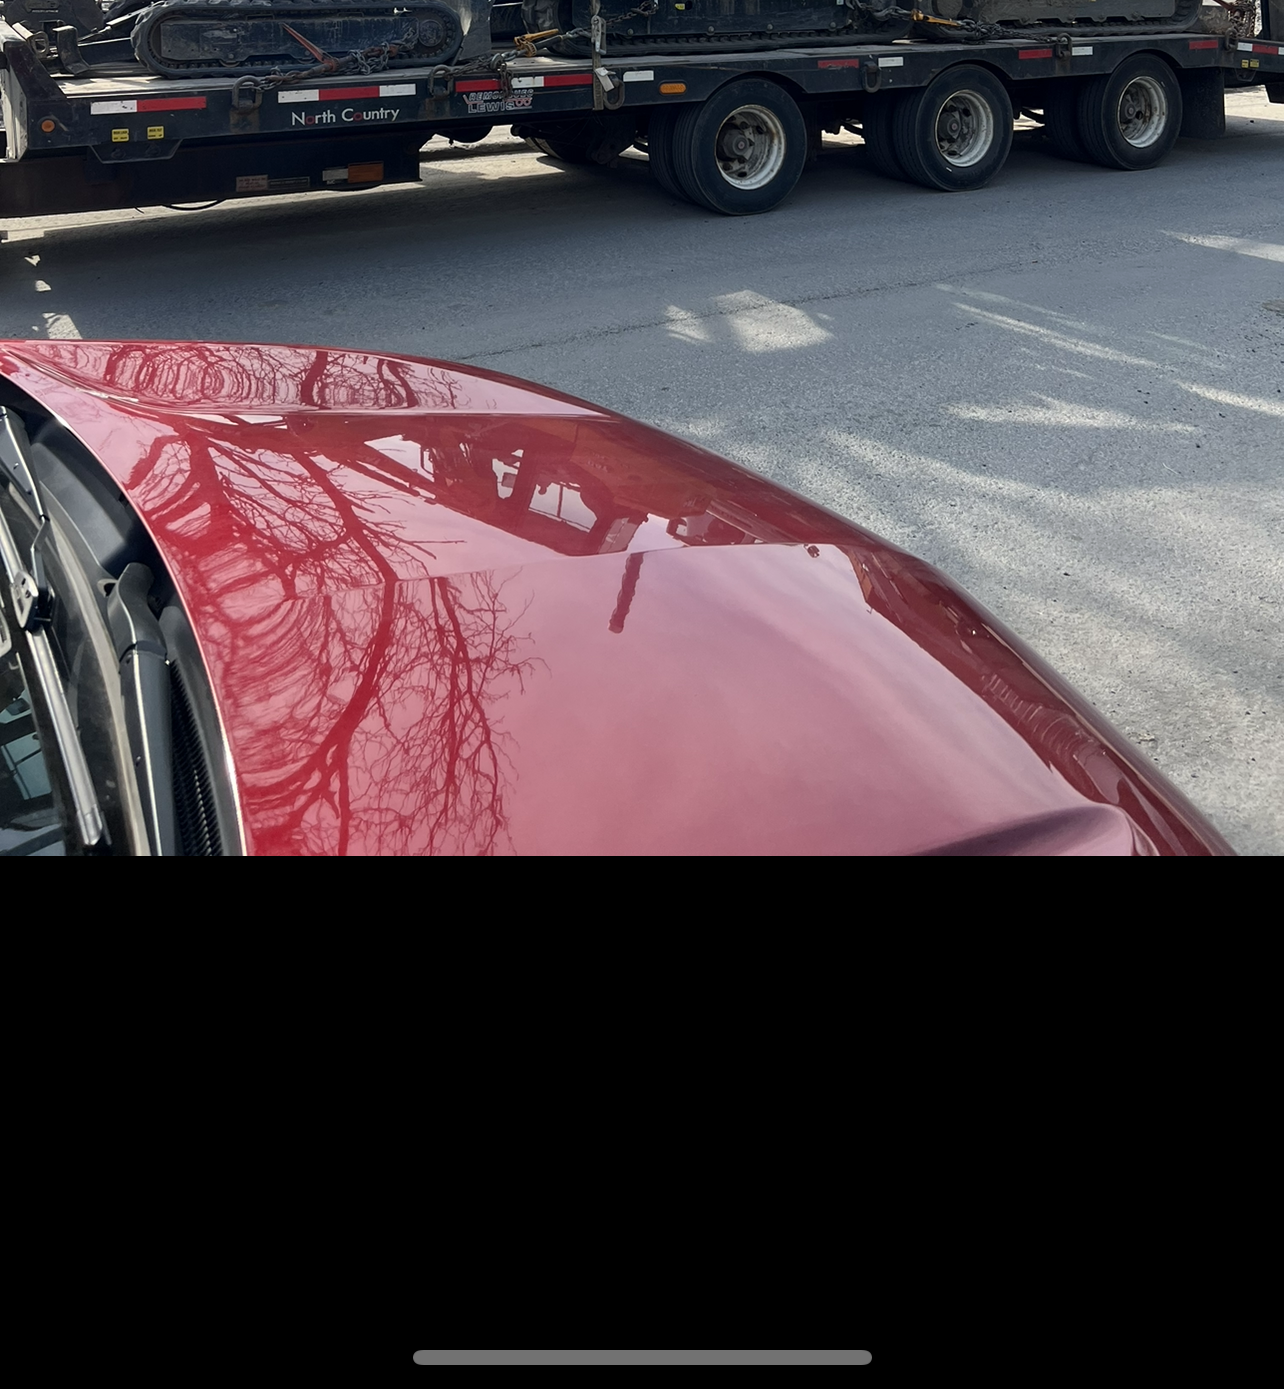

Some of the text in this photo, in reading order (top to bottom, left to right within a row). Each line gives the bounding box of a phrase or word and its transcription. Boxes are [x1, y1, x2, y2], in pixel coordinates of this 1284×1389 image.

[468, 89, 534, 101] REMOUES
[468, 101, 515, 113] LEWIS
[291, 107, 400, 126] North Country
